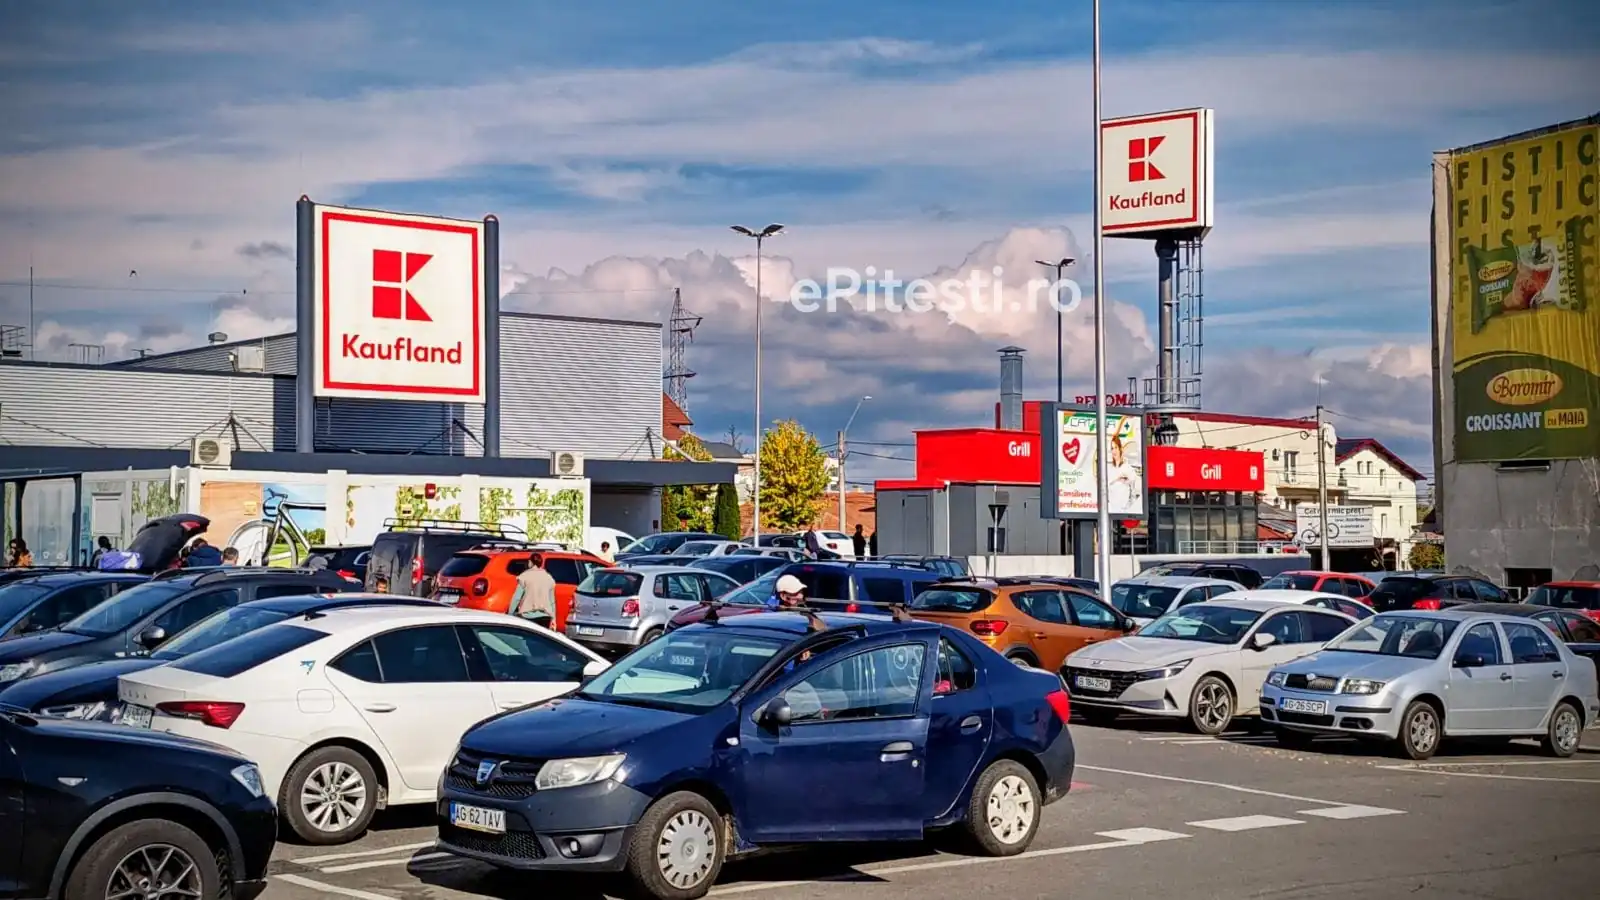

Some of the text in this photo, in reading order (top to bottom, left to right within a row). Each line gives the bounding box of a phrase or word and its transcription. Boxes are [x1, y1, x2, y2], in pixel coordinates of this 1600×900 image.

[1457, 133, 1595, 191] FISTIC
[1109, 188, 1186, 211] Kaufland
[1457, 174, 1595, 228] FISTIC
[342, 333, 463, 365] Kaufland
[1493, 374, 1556, 398] Boromir
[1466, 411, 1542, 433] CROISSANT
[1558, 410, 1585, 427] MAIA
[1008, 441, 1031, 457] Grill
[1201, 463, 1222, 480] Grill
[455, 804, 502, 829] AG 62 TAV
